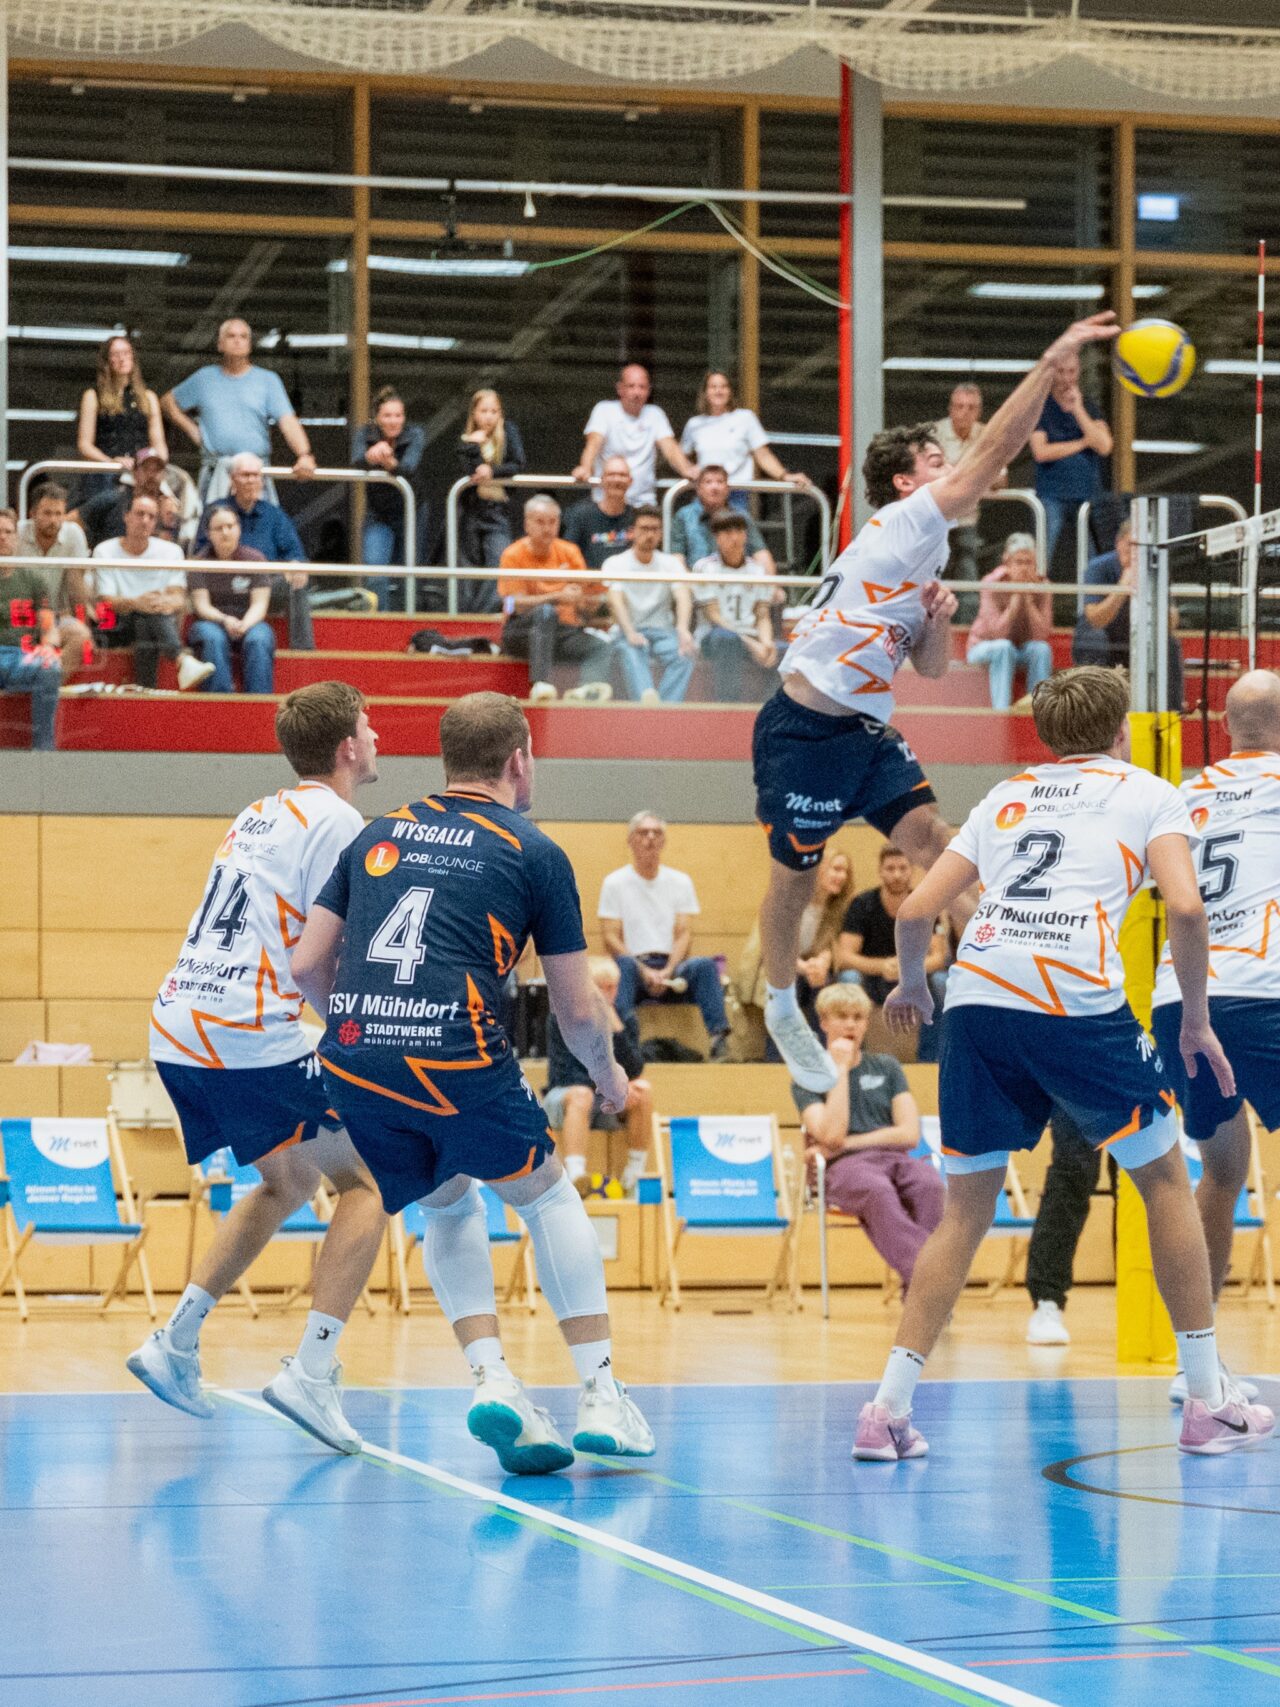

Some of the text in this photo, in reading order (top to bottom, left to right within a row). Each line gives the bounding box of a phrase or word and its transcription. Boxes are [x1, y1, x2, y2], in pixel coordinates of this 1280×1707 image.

[391, 821, 475, 847] WYSGALLA
[402, 851, 486, 874] JOBLOUNGE
[428, 866, 450, 876] GmbH
[1001, 829, 1065, 901] 2
[187, 865, 252, 951] 14
[366, 886, 435, 985] 4
[1001, 927, 1072, 943] STADTWERKE
[329, 993, 460, 1020] TSV Mühldorf
[363, 1037, 442, 1047] mühldorf am inn
[365, 1023, 443, 1037] STADTWERKE
